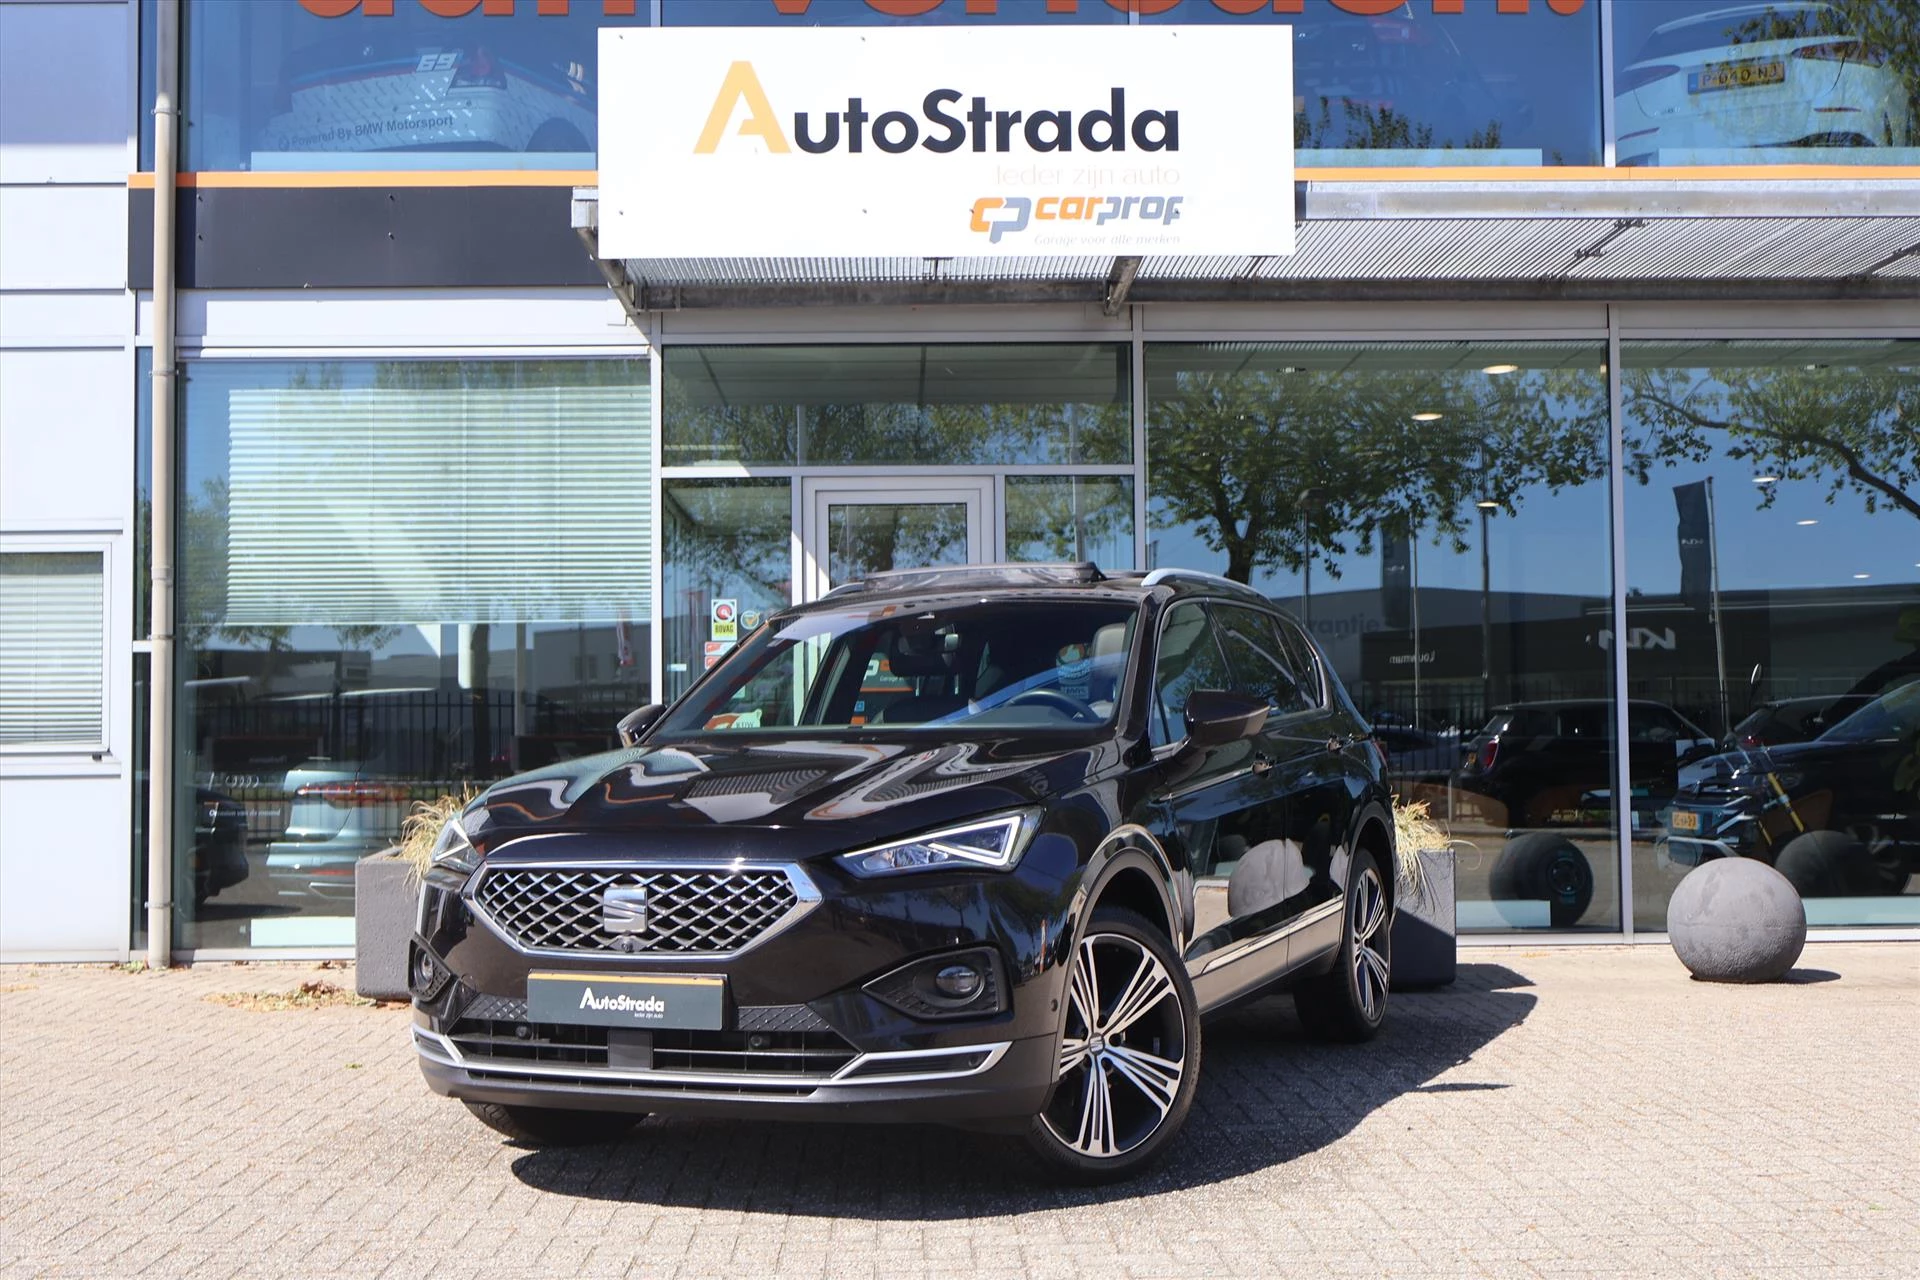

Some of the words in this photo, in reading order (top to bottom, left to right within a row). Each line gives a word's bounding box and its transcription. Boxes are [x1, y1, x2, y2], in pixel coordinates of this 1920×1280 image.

[416, 53, 457, 72] 69
[692, 60, 1180, 155] AutoStrada
[292, 128, 335, 146] Powered
[337, 125, 352, 141] By
[355, 121, 383, 136] BMW
[386, 115, 454, 133] Motorsport
[1072, 164, 1114, 189] zijn
[1122, 164, 1181, 185] auto
[1034, 234, 1078, 247] Garage
[1080, 235, 1107, 245] voor
[1110, 234, 1131, 245] alle
[1135, 234, 1181, 245] merken
[579, 987, 665, 1012] AutoStrada
